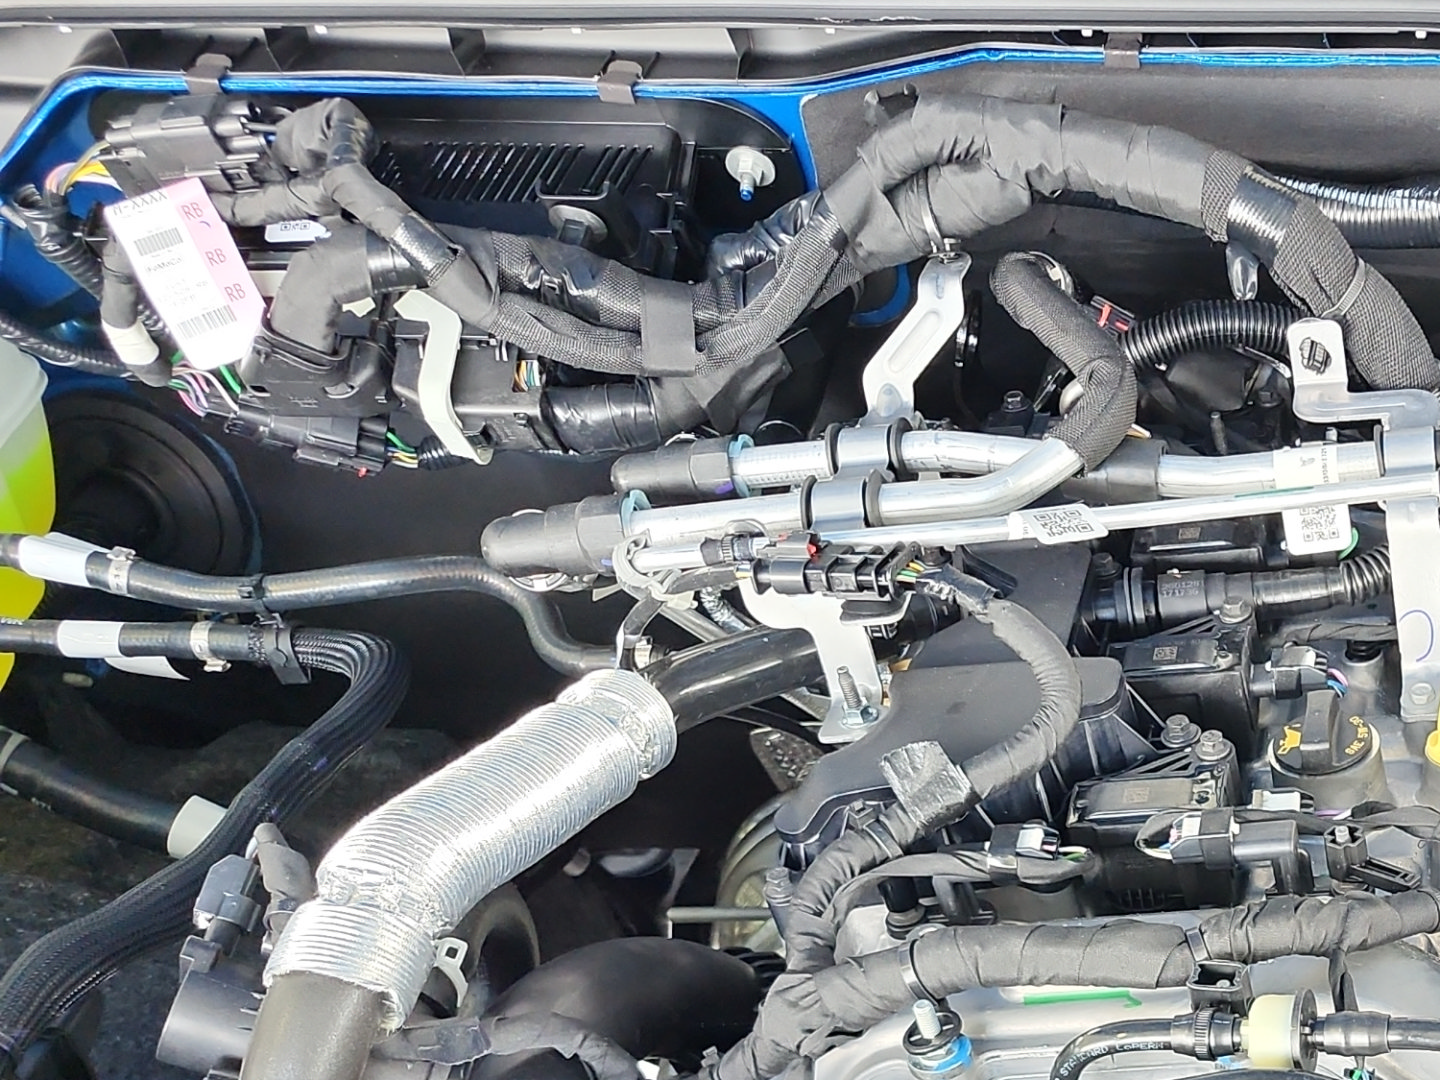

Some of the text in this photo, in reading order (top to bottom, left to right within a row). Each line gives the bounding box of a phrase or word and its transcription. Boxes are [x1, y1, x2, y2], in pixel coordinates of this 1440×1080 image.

[180, 201, 204, 221] RB
[205, 247, 227, 266] RB
[224, 283, 246, 303] RB
[1344, 740, 1365, 755] SAE
